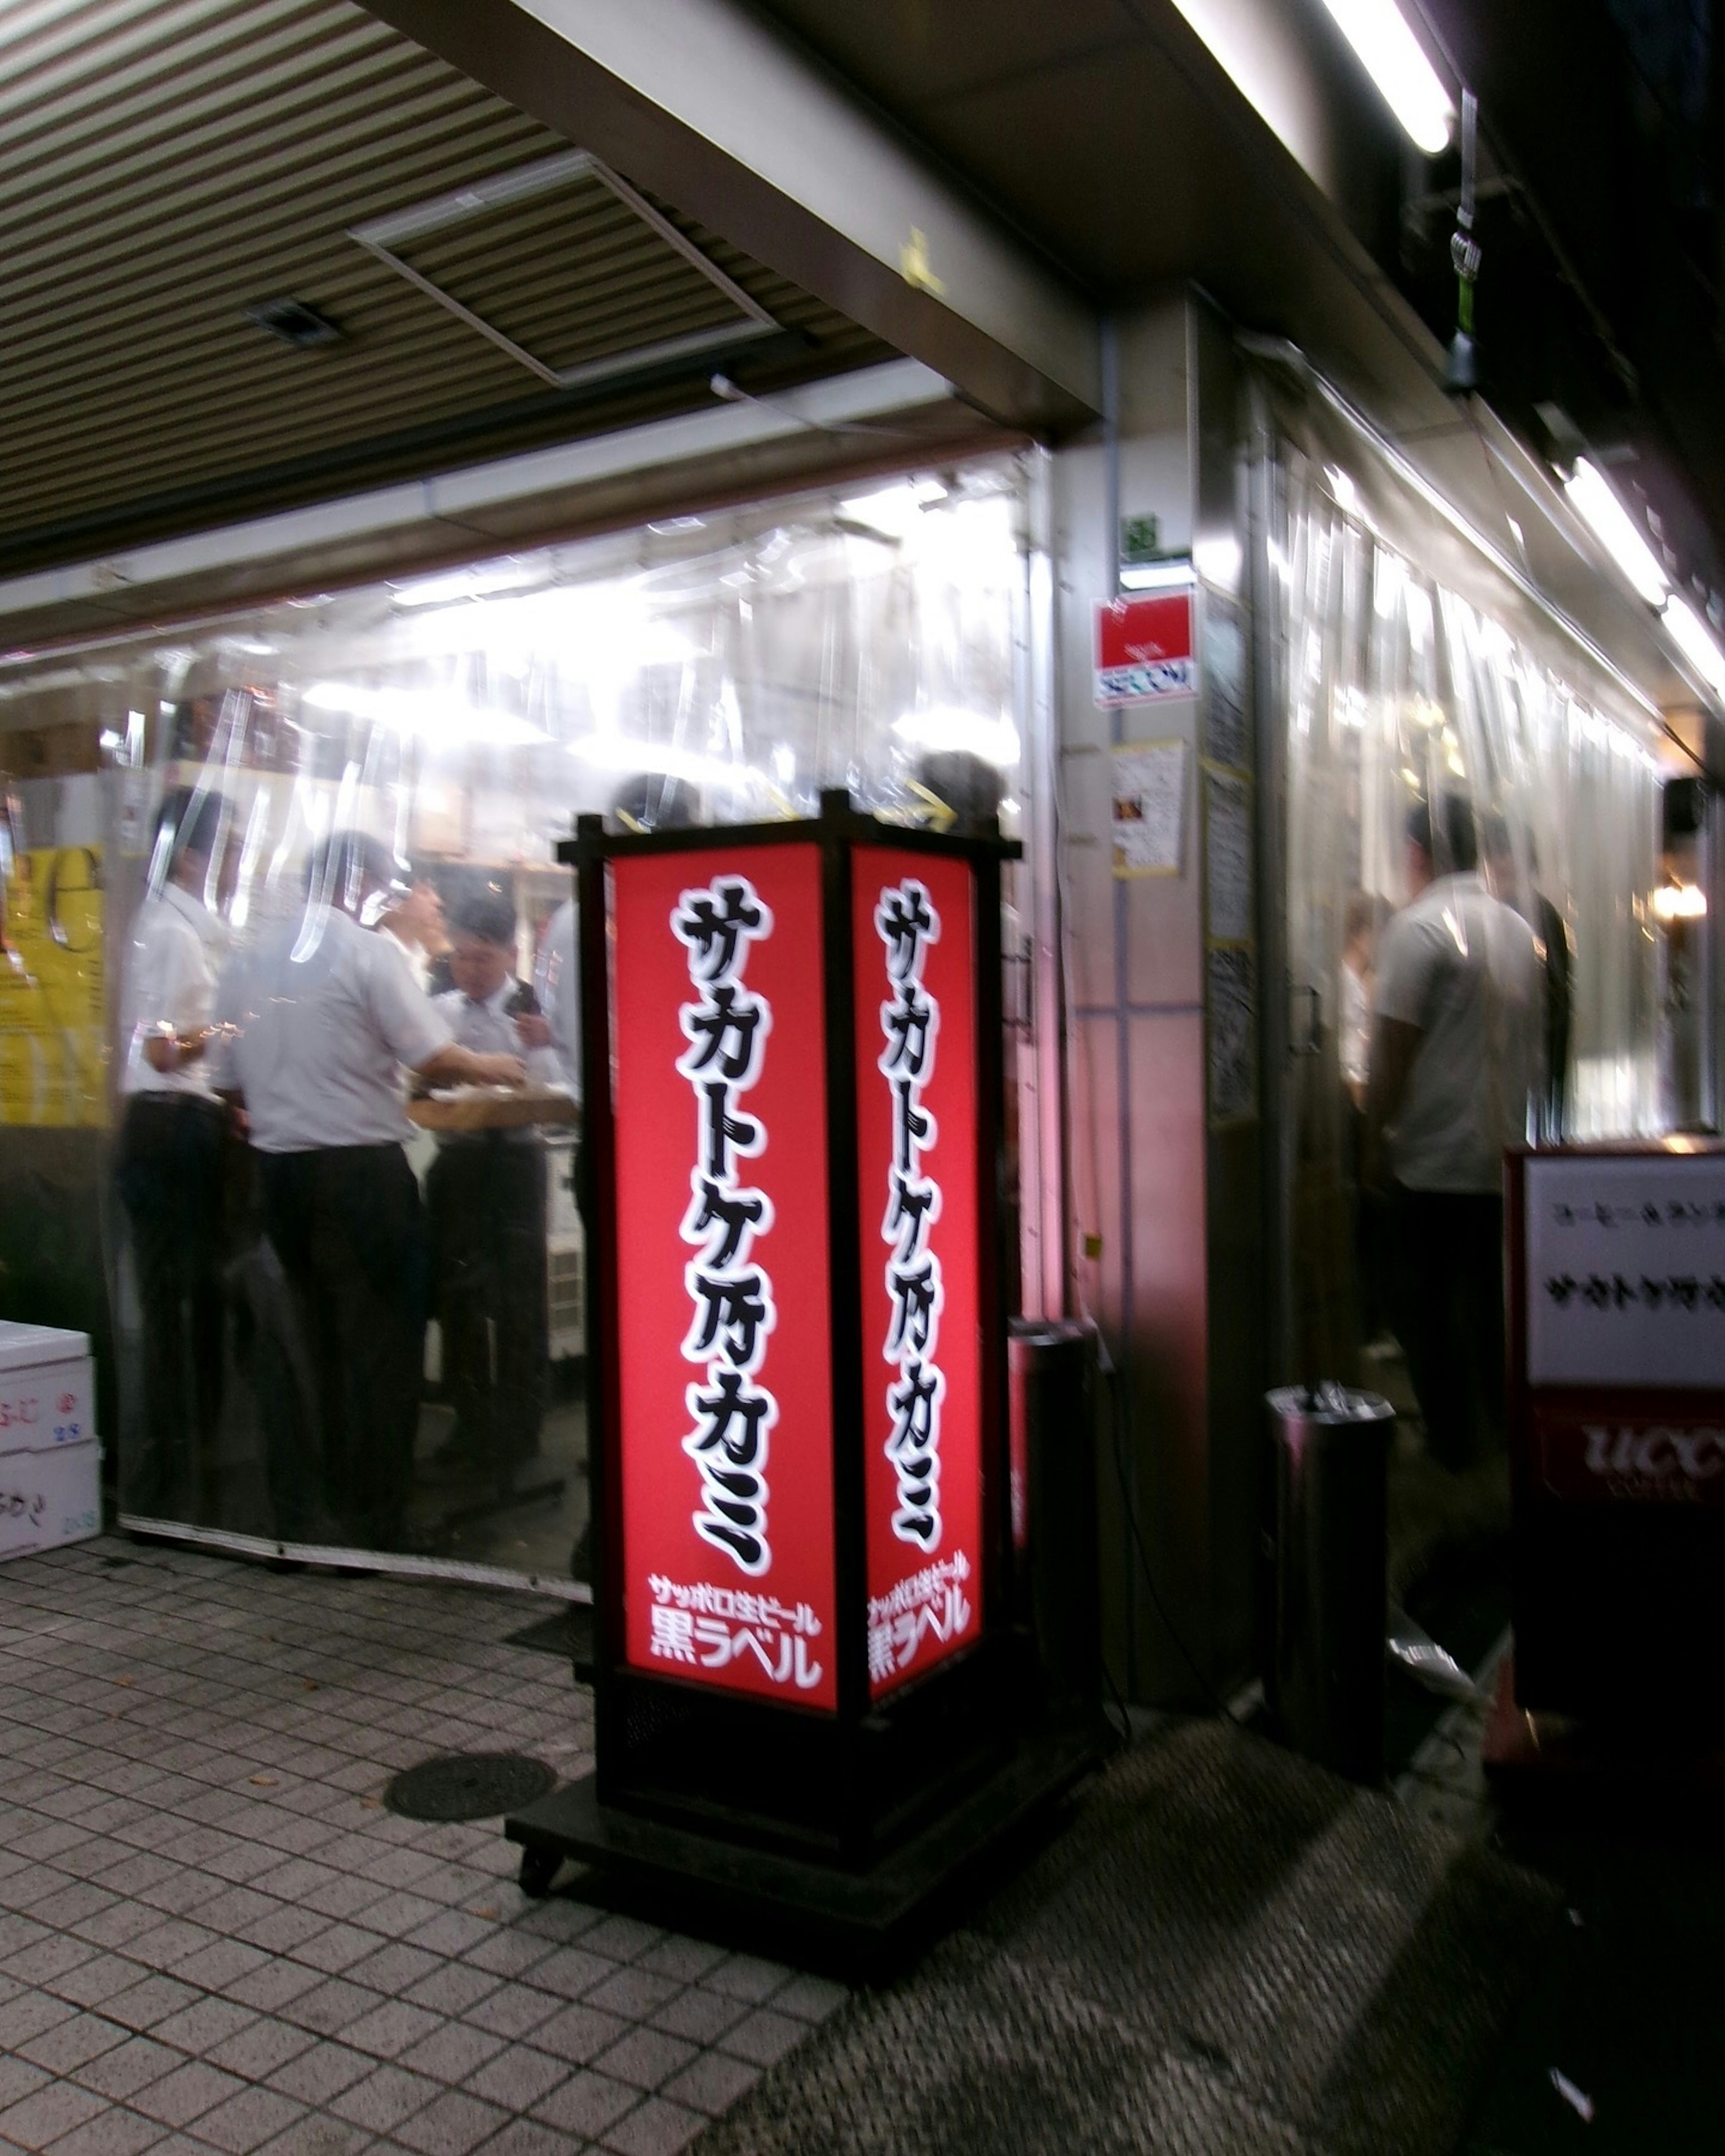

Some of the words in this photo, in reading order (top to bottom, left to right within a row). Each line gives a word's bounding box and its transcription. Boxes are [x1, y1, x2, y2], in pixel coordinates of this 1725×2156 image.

[648, 1573, 823, 1636] サッポロ生ビール
[867, 1549, 971, 1626] サッポロ生ビール
[650, 1604, 823, 1689] 黒ラベル
[867, 1583, 971, 1683] 黒ラベル
